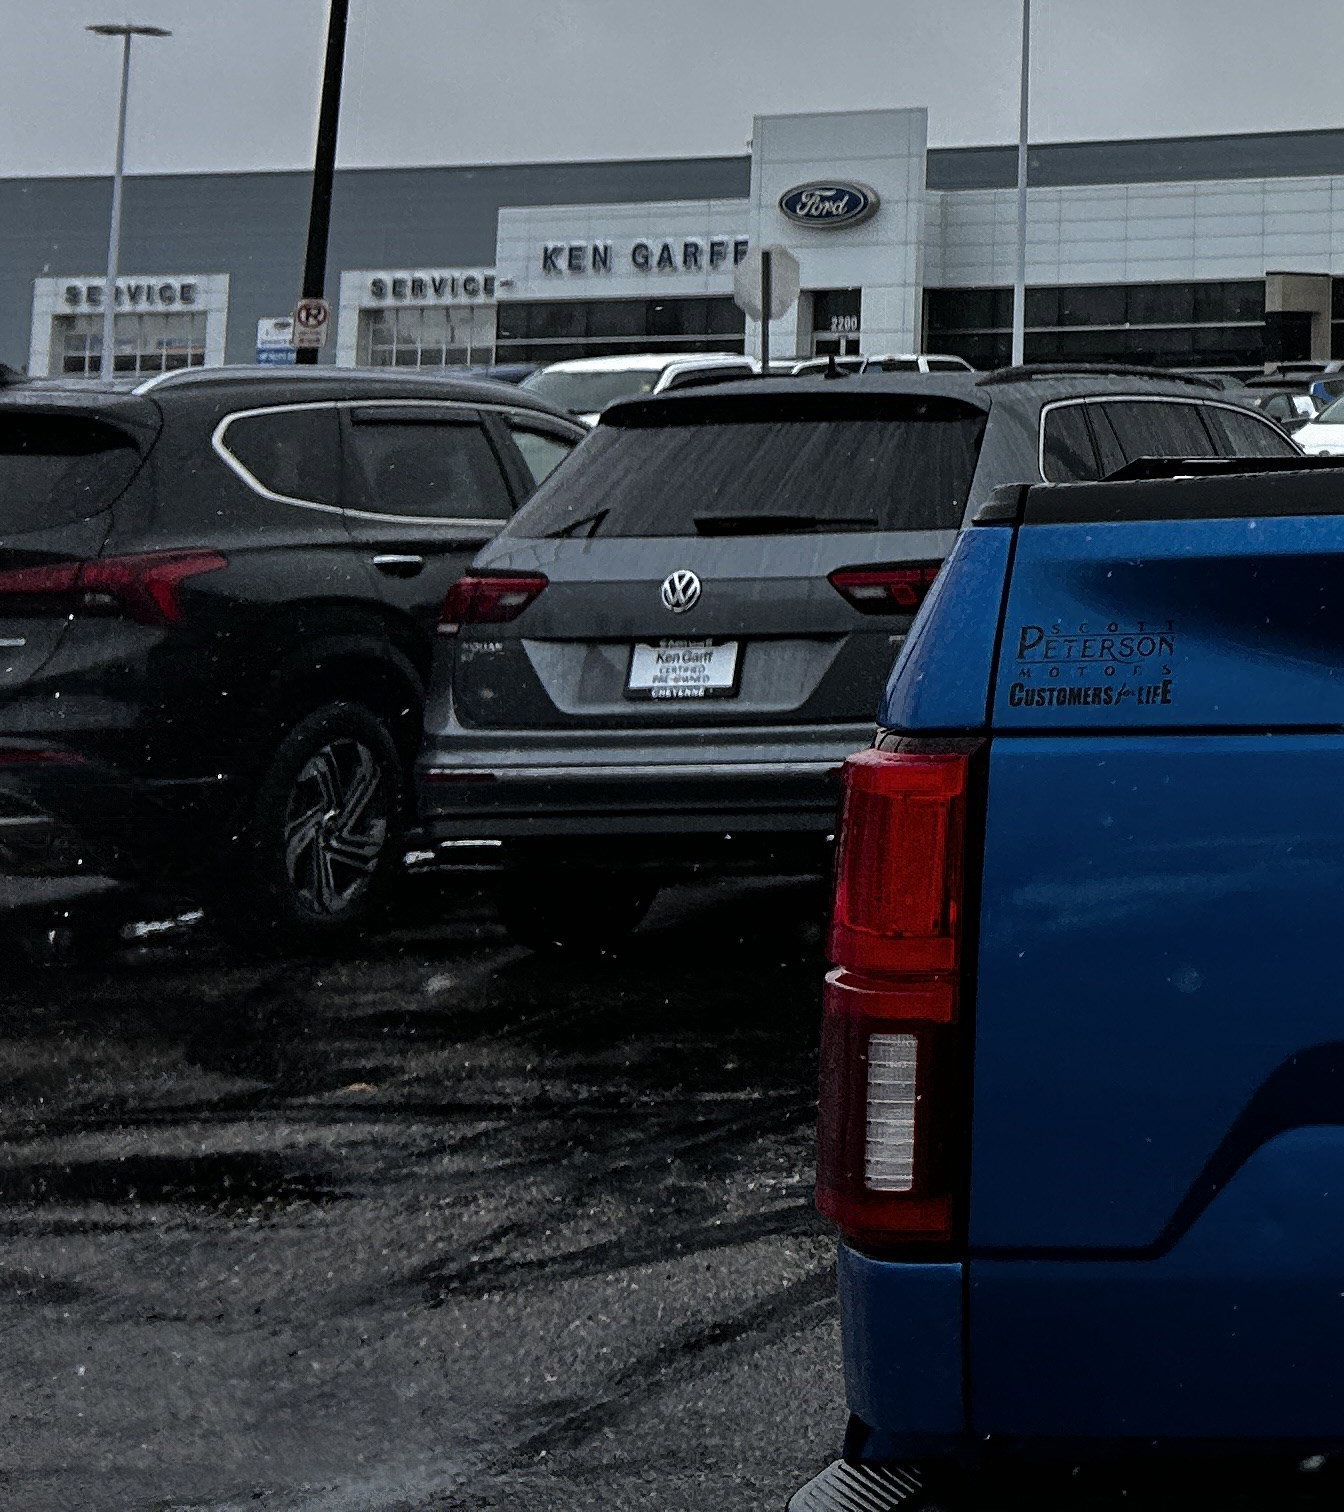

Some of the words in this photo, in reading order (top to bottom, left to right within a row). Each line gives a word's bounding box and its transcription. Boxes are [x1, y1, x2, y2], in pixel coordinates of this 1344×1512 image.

[796, 188, 850, 217] Ford
[542, 242, 612, 273] KEN
[371, 274, 496, 299] SERVICE
[830, 315, 858, 332] 2200
[1050, 619, 1175, 635] SCOTT
[1015, 625, 1175, 662] PETERSON
[655, 650, 681, 665] Ken
[1018, 664, 1173, 678] MOTORS
[1009, 682, 1114, 707] CUSTOMERS
[1136, 679, 1173, 705] LIFE
